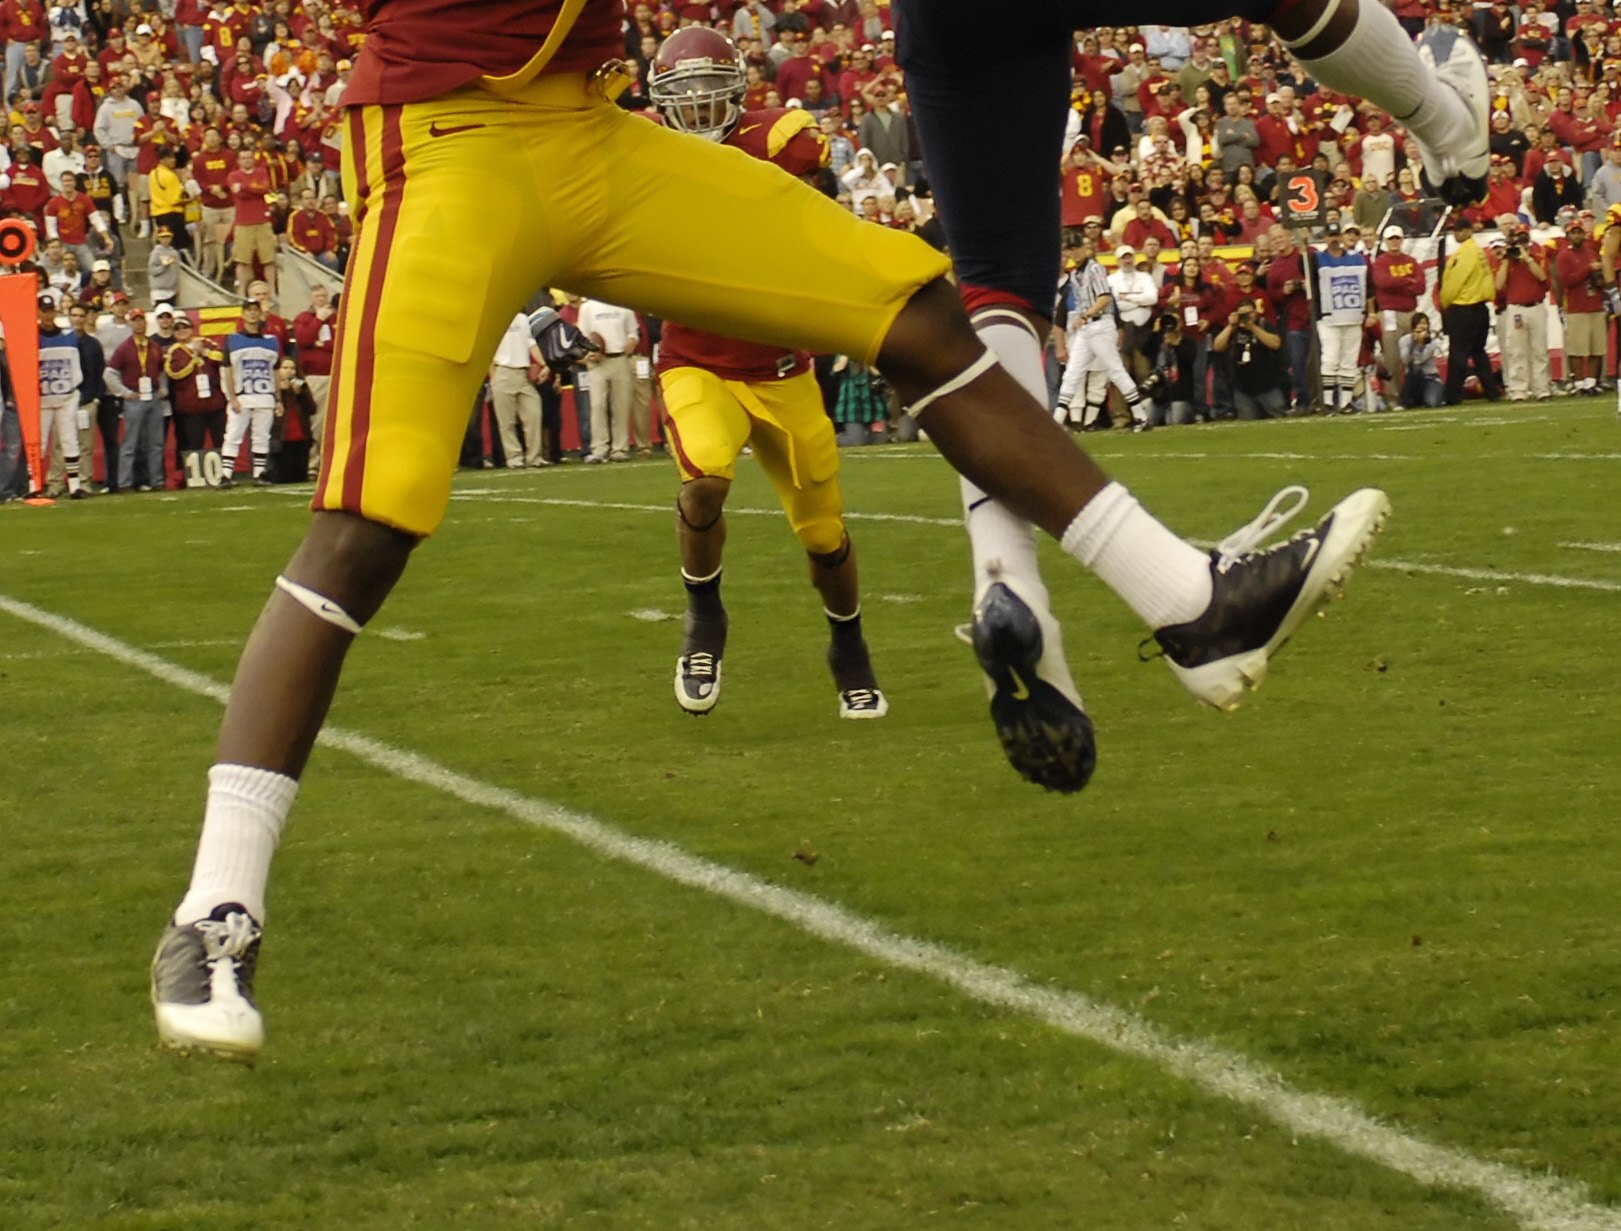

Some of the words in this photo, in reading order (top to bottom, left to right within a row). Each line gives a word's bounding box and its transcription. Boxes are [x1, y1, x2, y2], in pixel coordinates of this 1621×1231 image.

[1077, 173, 1093, 197] 8
[1287, 175, 1319, 213] 3
[1333, 294, 1361, 308] 10
[243, 378, 276, 395] 10
[186, 452, 223, 488] 10
